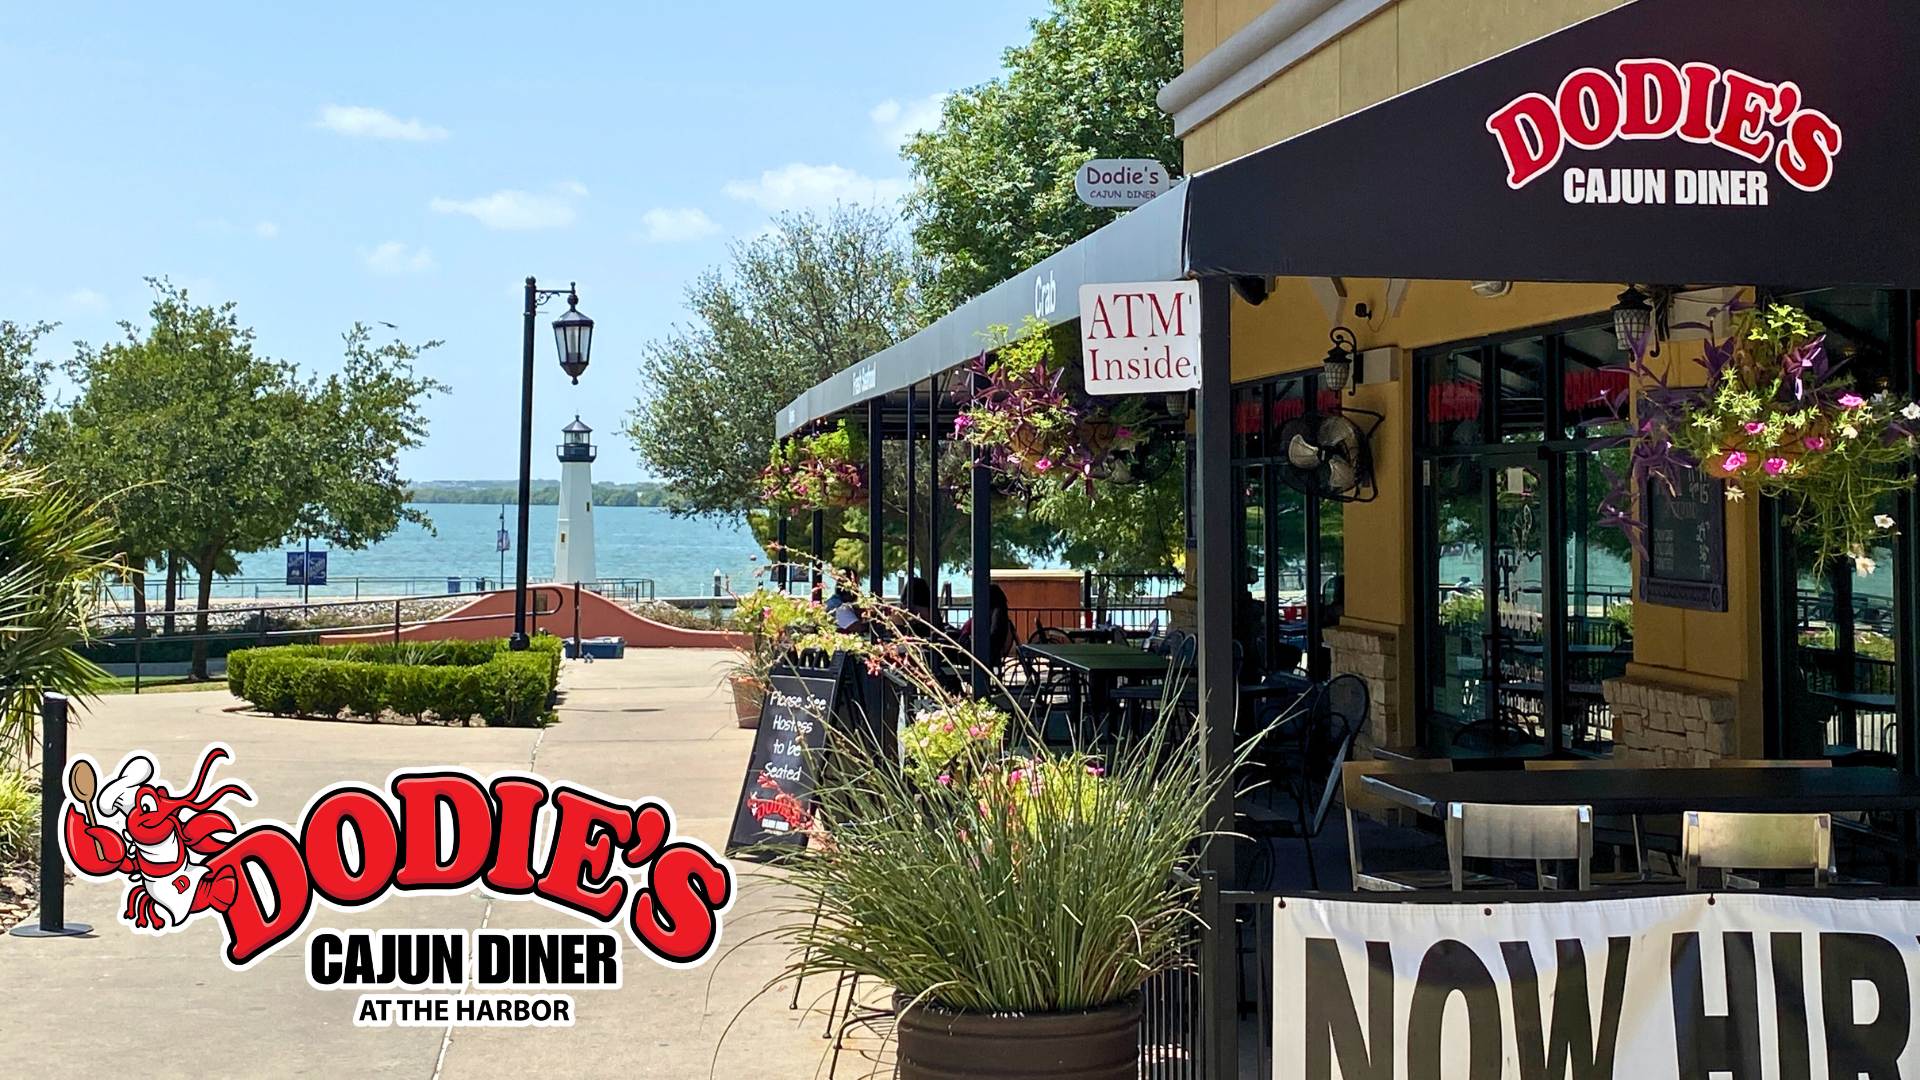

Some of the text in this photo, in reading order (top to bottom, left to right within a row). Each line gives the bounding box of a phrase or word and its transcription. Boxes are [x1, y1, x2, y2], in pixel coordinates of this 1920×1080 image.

[1486, 58, 1842, 192] DODIE'S
[1086, 166, 1159, 185] Dodie's
[1563, 168, 1768, 206] CAJUN DINER
[1089, 190, 1157, 199] CAJUN DINER
[1034, 270, 1056, 318] Crab
[1088, 292, 1184, 340] ATM
[1090, 345, 1190, 381] Inside
[769, 691, 827, 711] Please See
[772, 714, 814, 734] Hostess
[773, 738, 801, 757] to be
[764, 762, 802, 782] Seated
[1304, 931, 1920, 1080] NOW HIR
